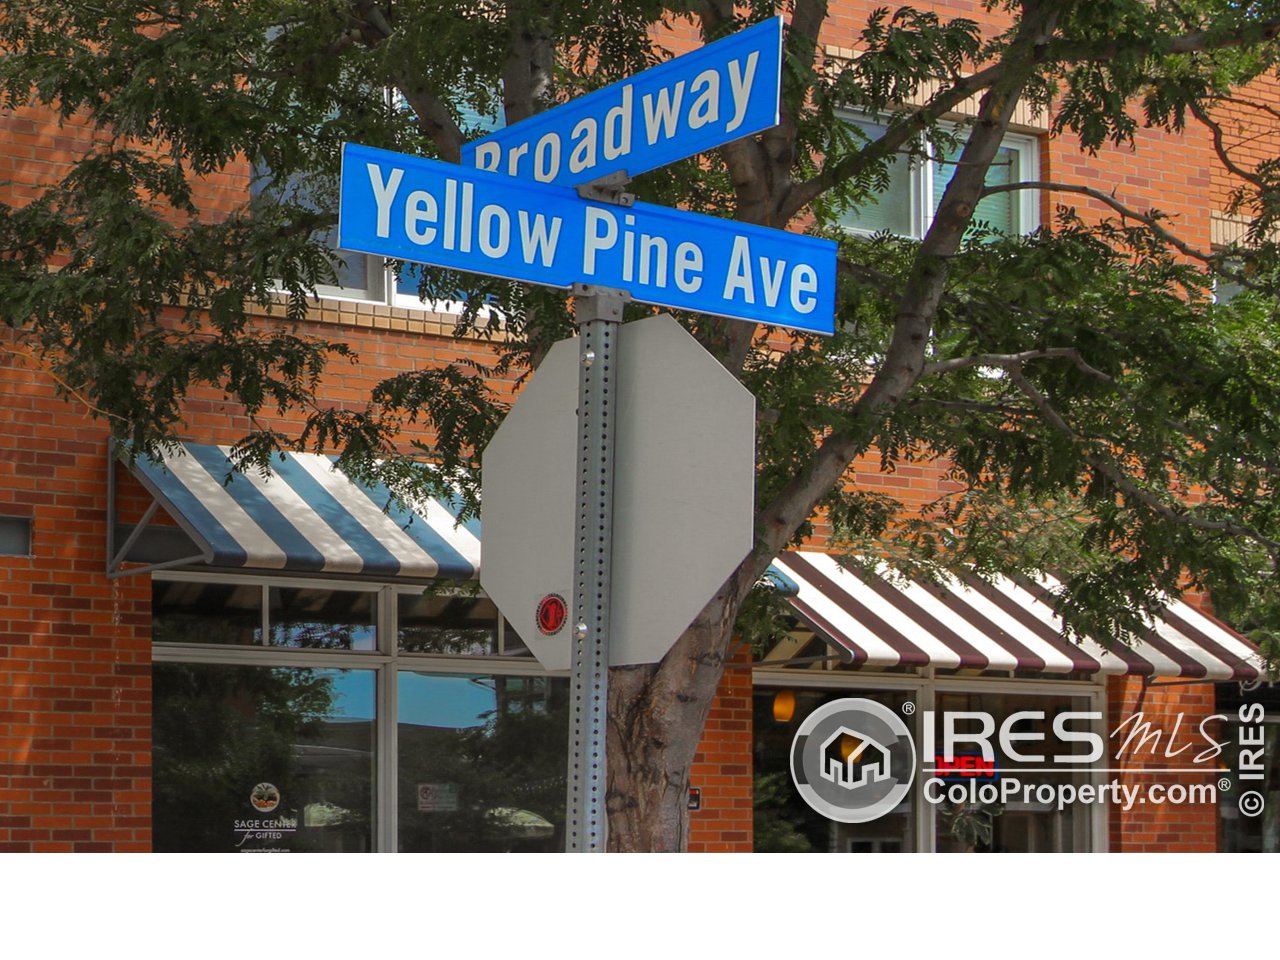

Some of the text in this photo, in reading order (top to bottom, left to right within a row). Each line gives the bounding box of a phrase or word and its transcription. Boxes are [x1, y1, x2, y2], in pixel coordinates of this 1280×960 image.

[366, 163, 817, 314] Yellow Pine Ave
[234, 819, 297, 828] SAGE CENTER
